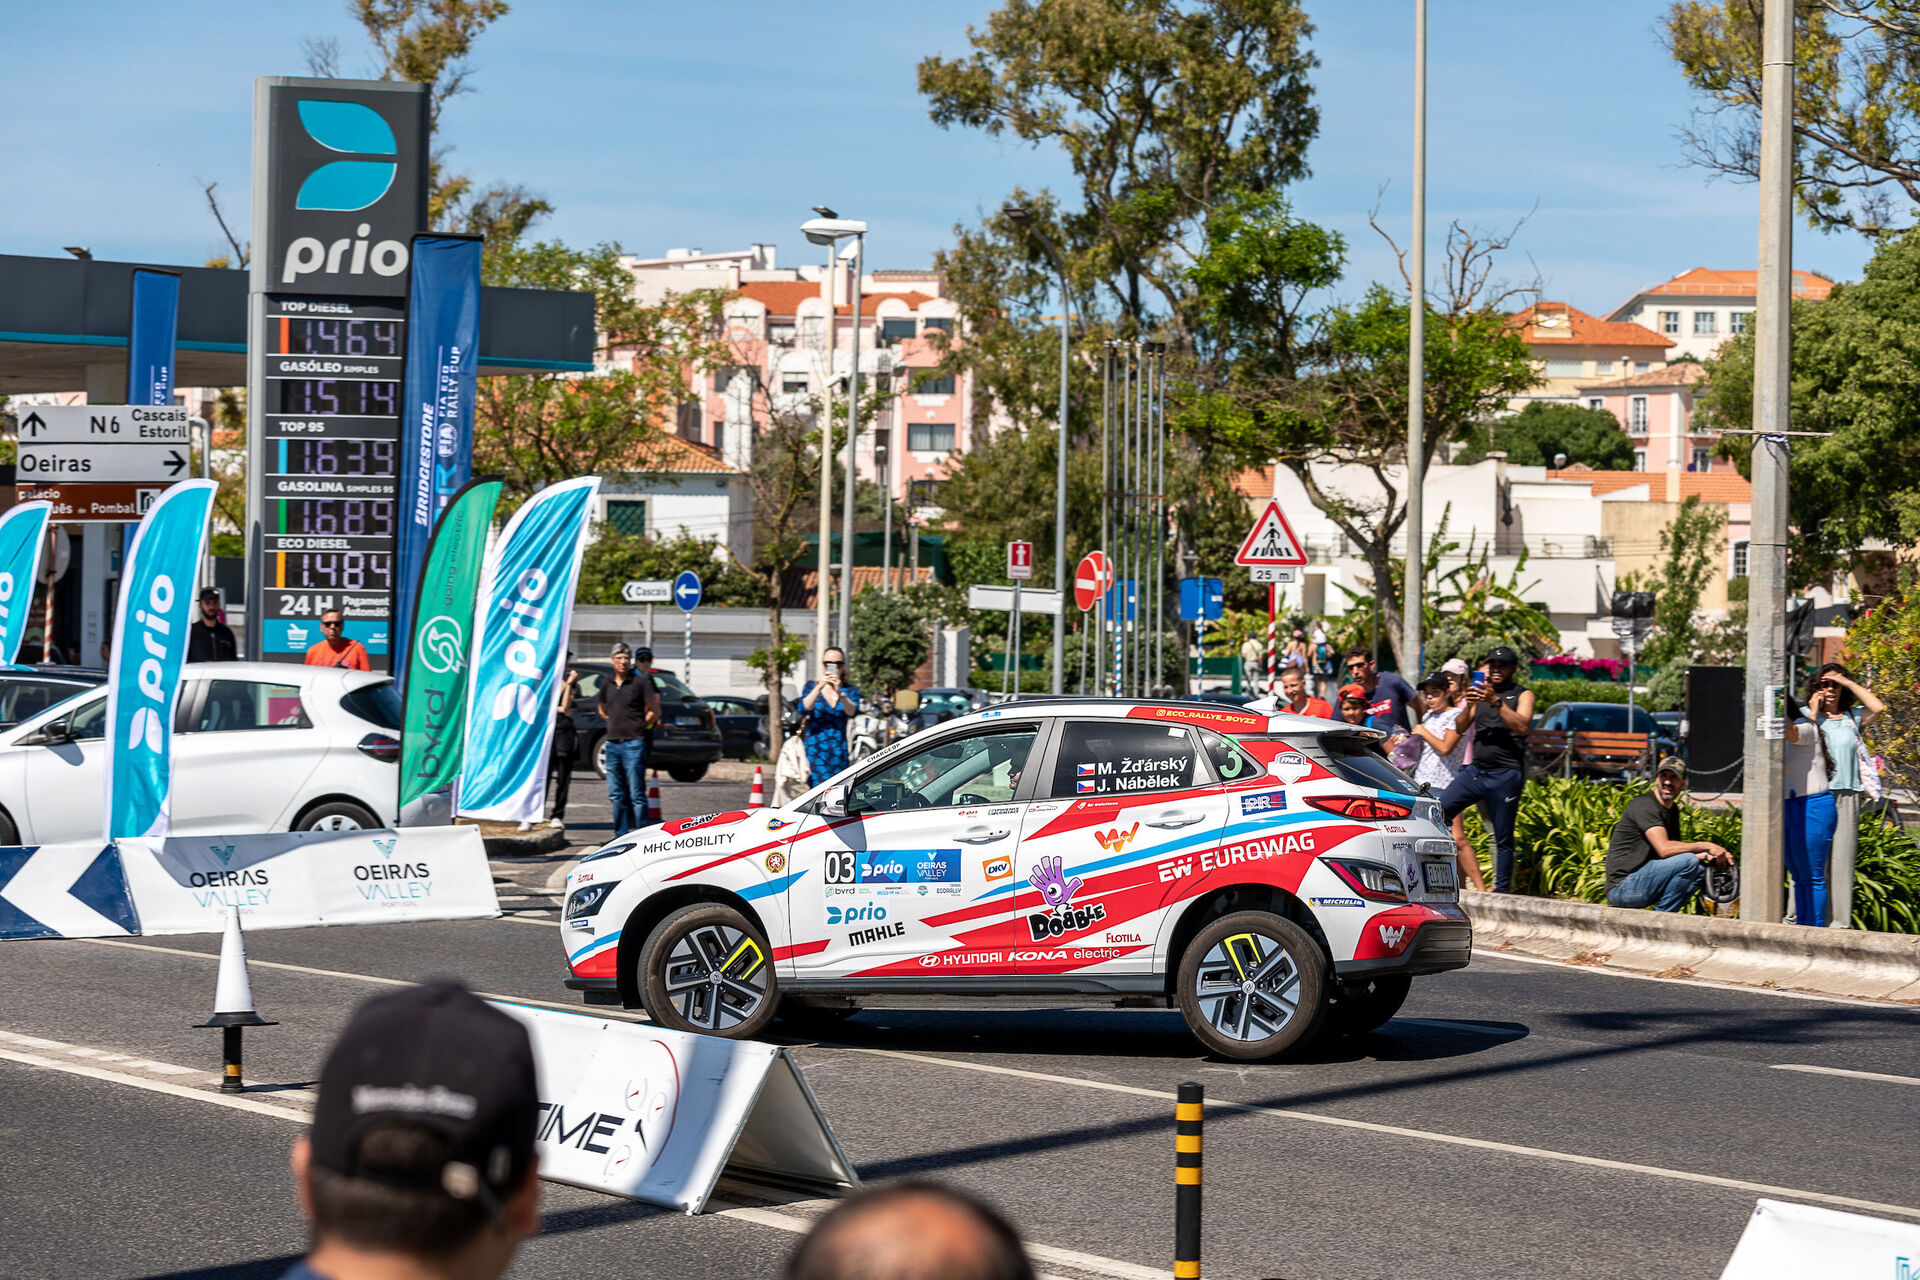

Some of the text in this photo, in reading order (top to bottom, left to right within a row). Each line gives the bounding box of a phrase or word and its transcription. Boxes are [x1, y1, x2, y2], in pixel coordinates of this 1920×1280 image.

[282, 223, 410, 283] prio
[280, 301, 354, 313] TOP DIESEL
[305, 320, 395, 355] 1.464
[279, 359, 379, 374] GASÓLEO SIMPLES
[447, 346, 462, 418] RALLY CUP
[131, 408, 187, 422] Cascais
[91, 416, 120, 434] N 6
[139, 425, 187, 438] Estoril
[279, 421, 325, 432] TOP 95
[20, 453, 92, 473] Oeiras
[304, 440, 394, 476] 1.639
[414, 402, 435, 527] BRIDGESTONE
[277, 481, 394, 493] GASOLINA SIMPLES 95
[91, 503, 136, 514] Pombal
[303, 500, 393, 536] 1.689
[277, 538, 351, 549] ECO DIESEL
[302, 552, 391, 589] 1.484
[1256, 570, 1290, 580] 25 m
[342, 595, 390, 607] Pagament
[635, 586, 668, 597] Cascais
[279, 595, 334, 616] 24 H
[500, 567, 549, 681] prio
[136, 574, 175, 704] prio
[1166, 710, 1257, 725] ECO_RALLYE_BOYZZ
[417, 688, 446, 779] byrd
[1097, 756, 1188, 775] M. Žďárský
[1219, 736, 1243, 778] 3
[1096, 773, 1180, 792] J. Nábělek
[643, 833, 735, 855] MHC MOBILITY
[1199, 832, 1315, 872] EUROWAG
[354, 862, 430, 881] OEIRAS
[825, 851, 856, 884] 03
[873, 860, 903, 877] prio
[916, 861, 947, 870] OEIRAS
[916, 869, 947, 878] VALLEY
[987, 862, 1008, 875] DKV
[189, 869, 269, 888] OEIRAS
[192, 888, 272, 908] VALLEY
[356, 880, 433, 900] VALLEY
[1322, 898, 1363, 906] MICHELIN
[845, 901, 887, 925] prio
[848, 921, 906, 947] MAHLE
[1106, 932, 1142, 944] FLOTILA
[942, 948, 1121, 967] HYUNDAI KONA electric
